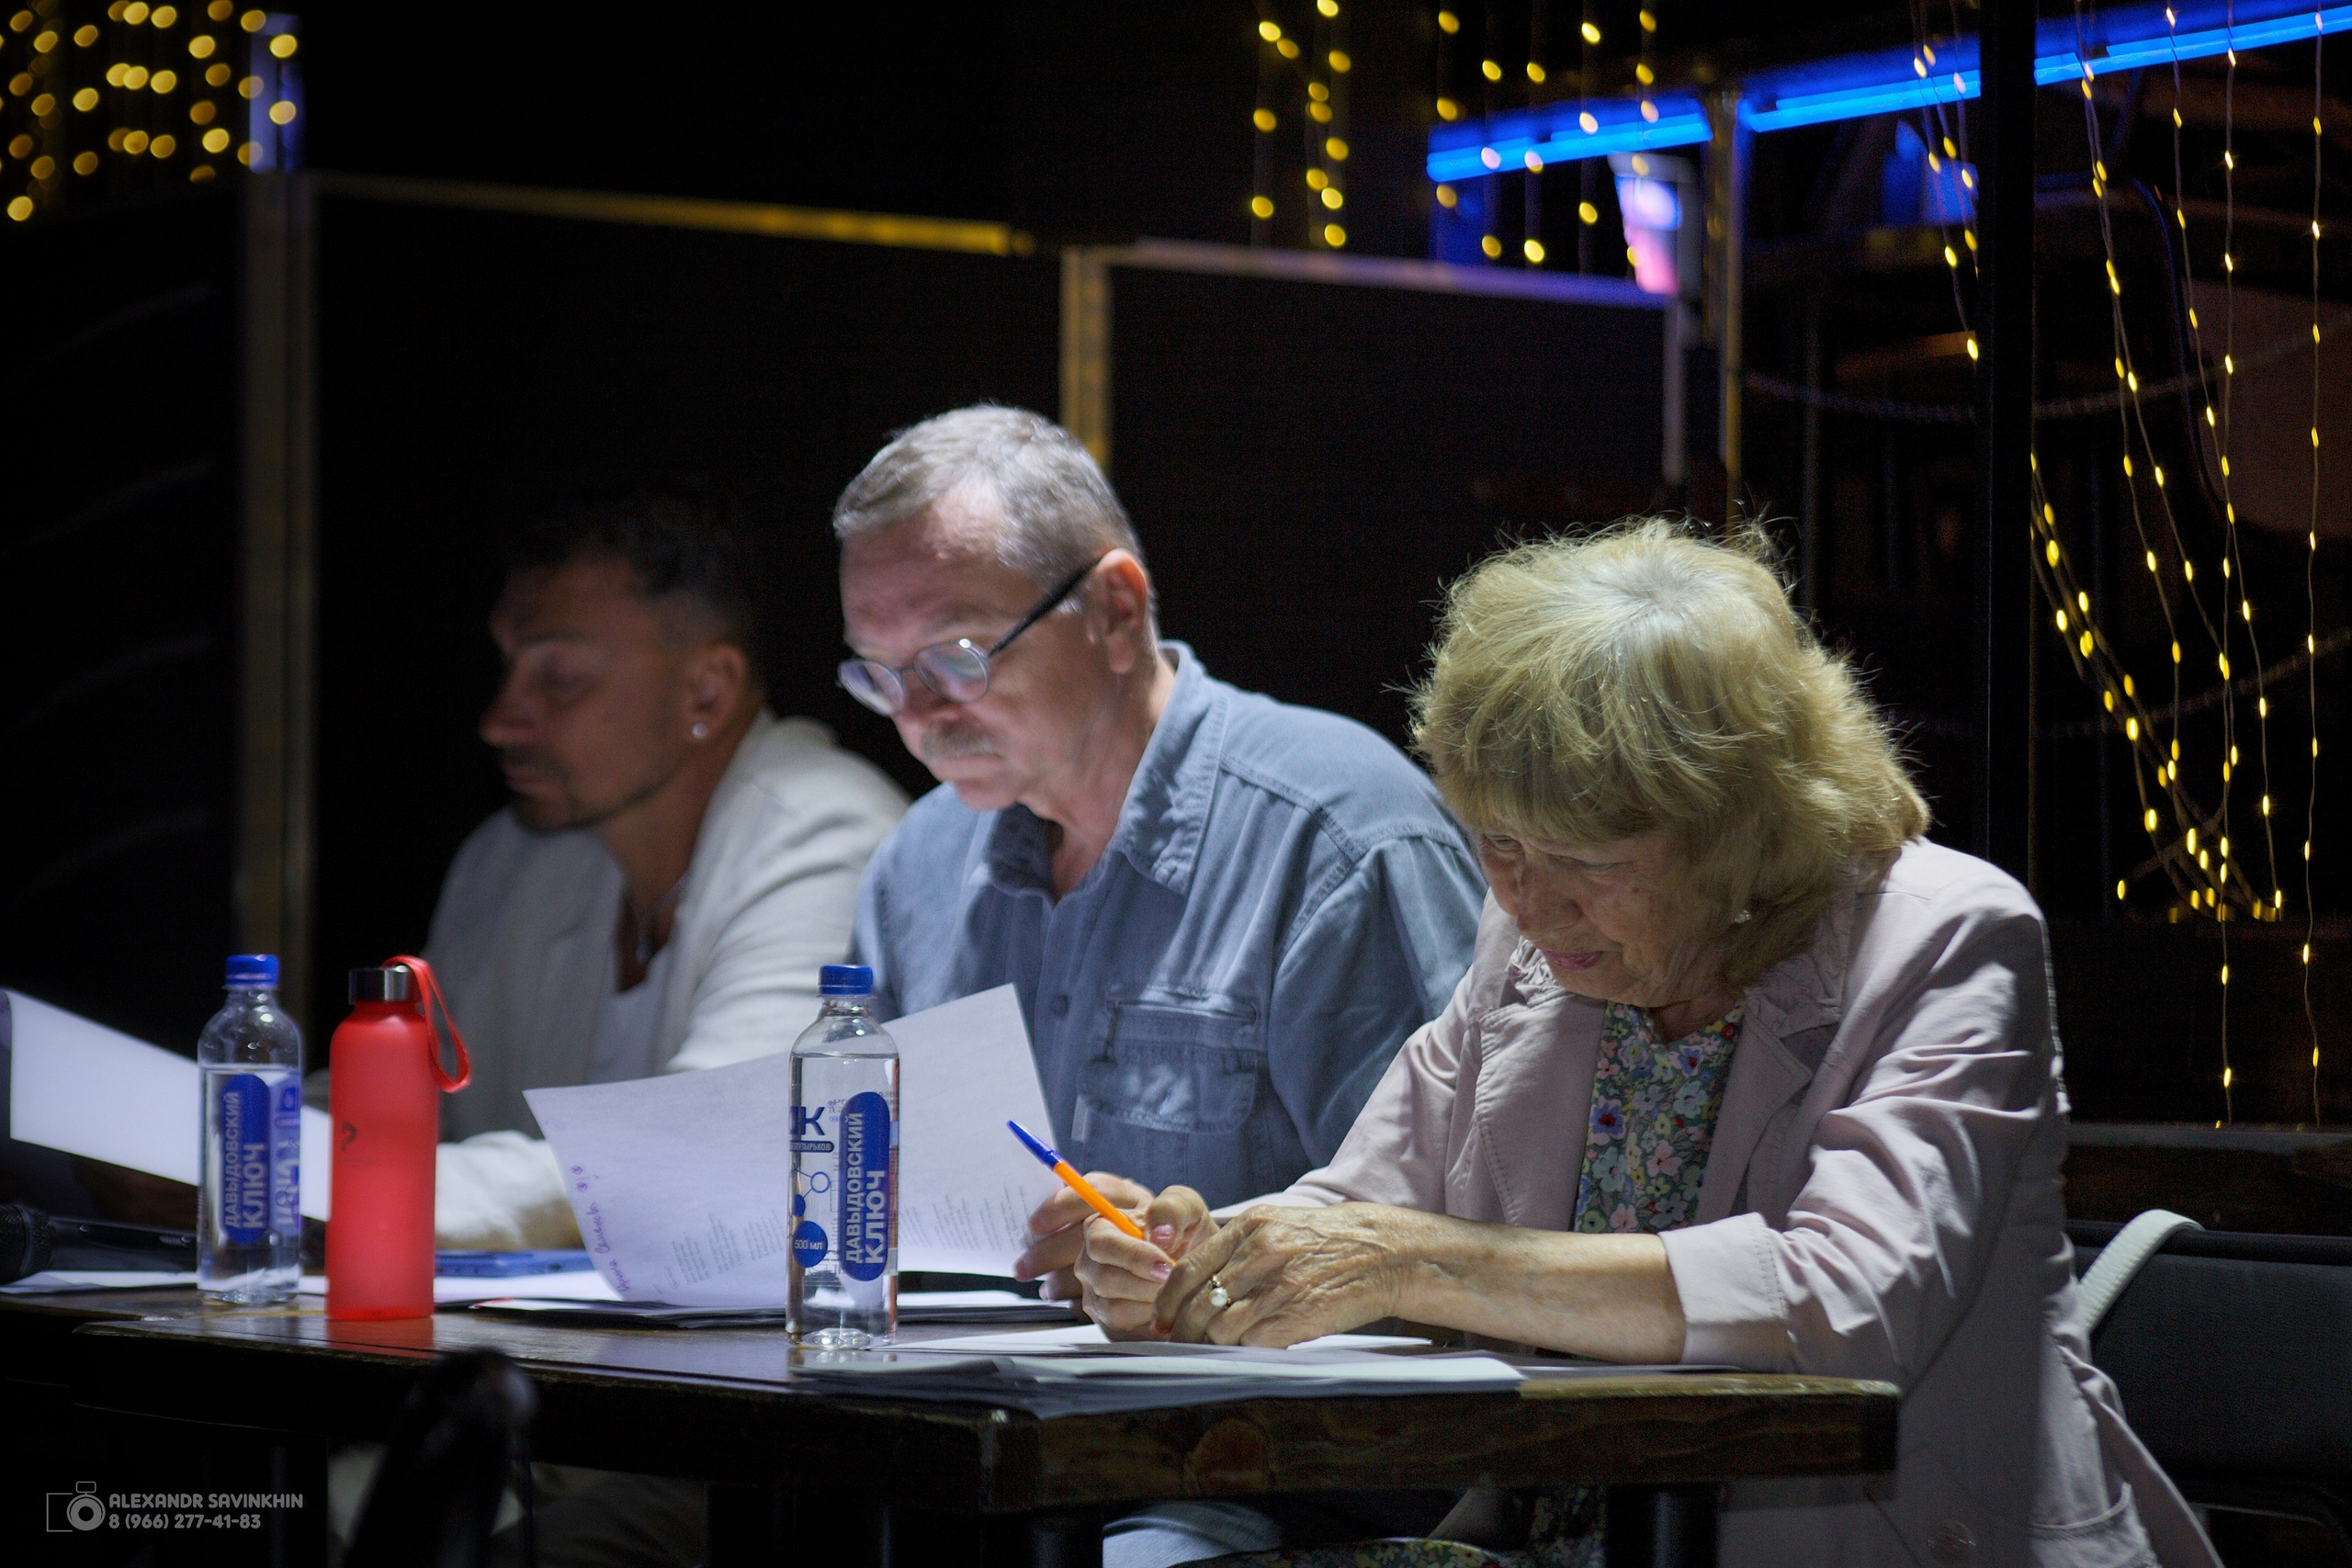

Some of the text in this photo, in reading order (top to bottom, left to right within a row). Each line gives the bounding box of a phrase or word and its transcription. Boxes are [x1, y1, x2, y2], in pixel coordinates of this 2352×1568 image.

[223, 1091, 242, 1228] ДАВЫДОВСКИЙ
[243, 1144, 265, 1229] КЛЮЧ
[845, 1112, 864, 1265] ДАВЫДОВСКИЙ
[794, 1239, 808, 1249] 500
[865, 1170, 886, 1265] КЛЮЧ
